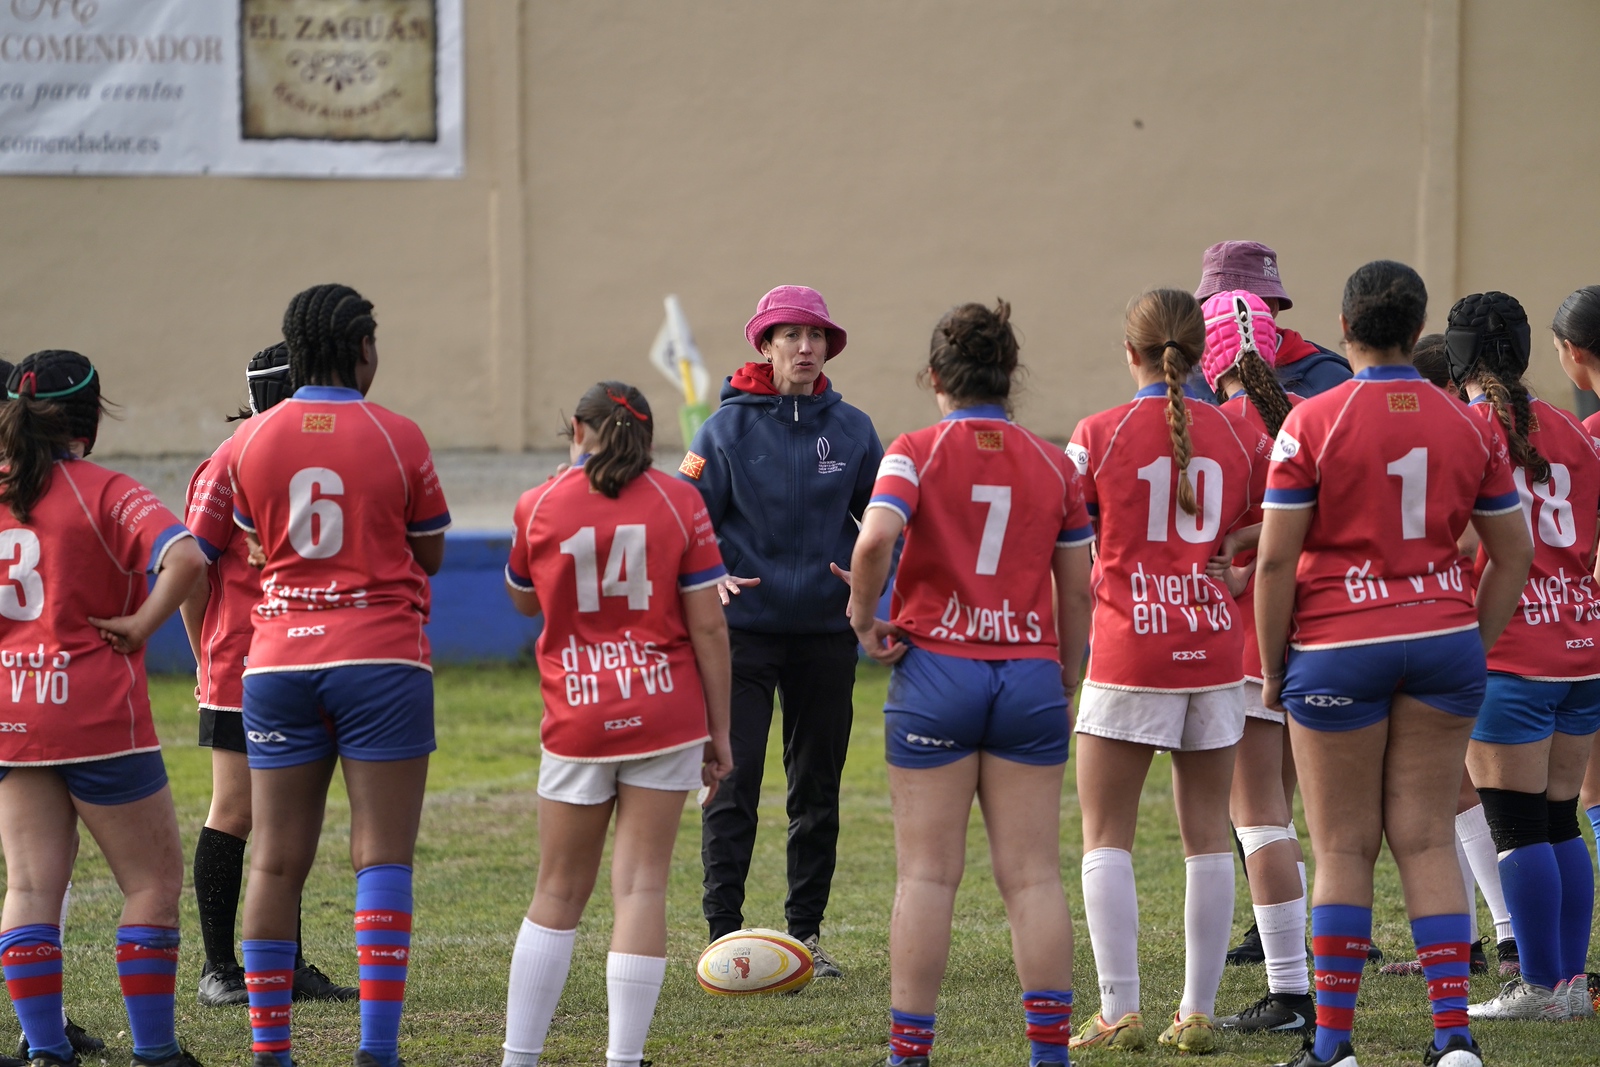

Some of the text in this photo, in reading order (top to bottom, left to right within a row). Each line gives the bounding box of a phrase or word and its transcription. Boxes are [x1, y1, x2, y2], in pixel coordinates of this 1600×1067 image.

[249, 15, 286, 40] EL
[0, 32, 223, 65] COMENDADOR
[26, 81, 92, 112] para
[1137, 456, 1224, 544] 10
[1386, 447, 1428, 540] 1
[1513, 463, 1577, 548] 18
[288, 466, 345, 560] 6
[971, 484, 1012, 576] 7
[559, 523, 653, 613] 14
[1133, 603, 1168, 635] en
[1172, 650, 1207, 661] REXS
[1565, 637, 1595, 649] REXS
[565, 673, 599, 707] en
[604, 716, 642, 731] REXS
